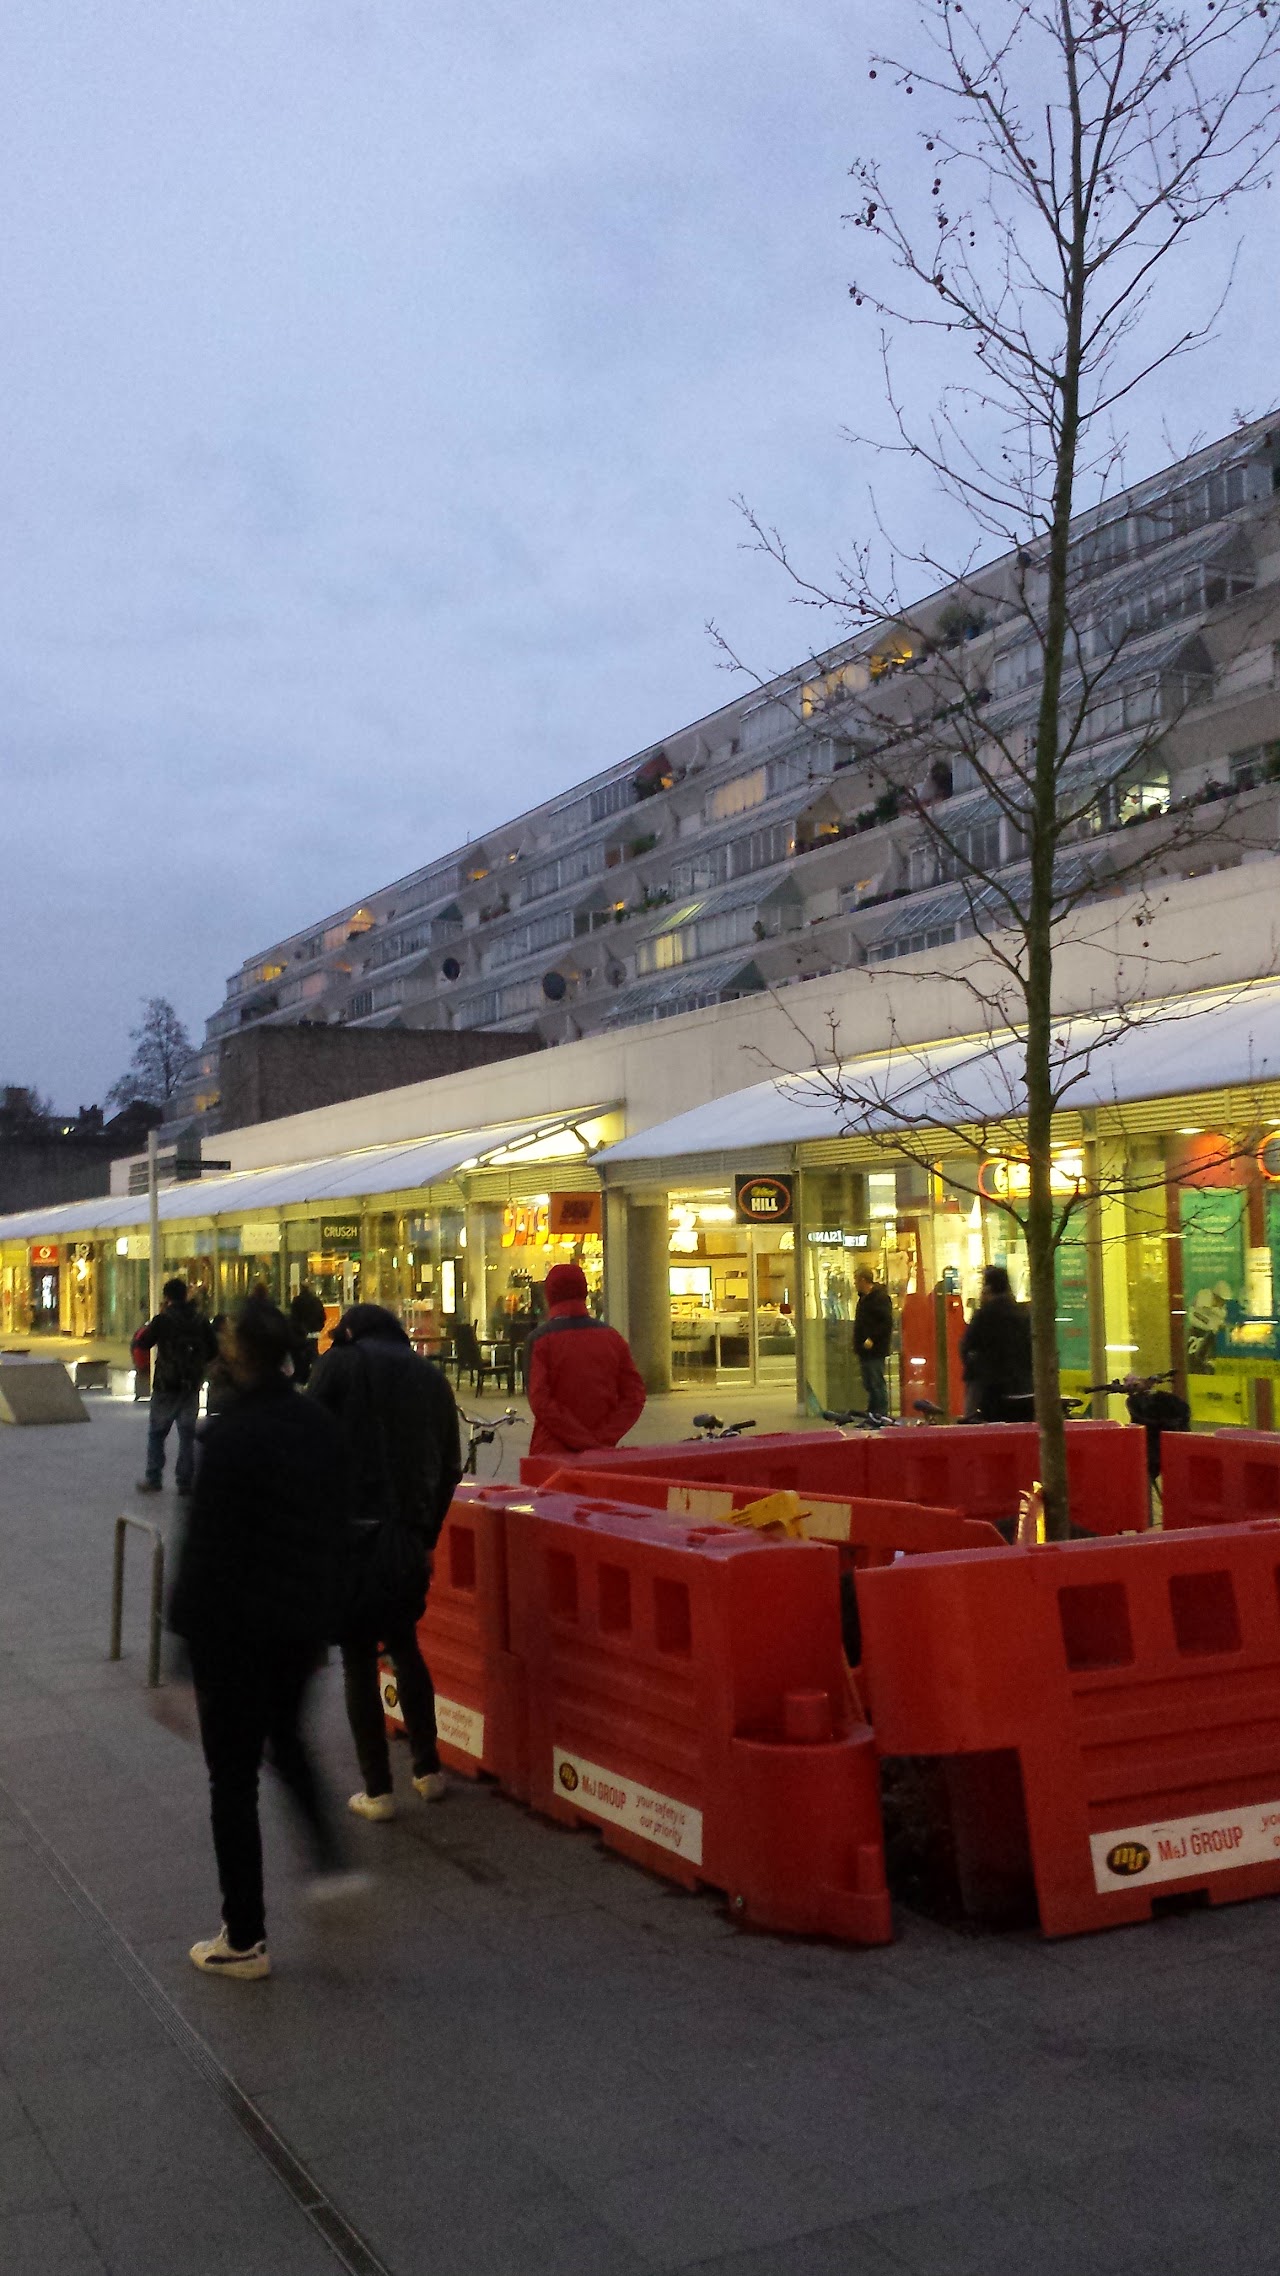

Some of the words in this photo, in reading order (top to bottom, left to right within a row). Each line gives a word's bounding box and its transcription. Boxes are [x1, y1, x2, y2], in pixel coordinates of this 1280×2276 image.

[751, 1197, 778, 1211] HILL
[598, 1781, 626, 1810] GROUP
[636, 1795, 655, 1808] your
[640, 1816, 653, 1828] our
[653, 1823, 683, 1847] priority
[1190, 1826, 1244, 1855] GROUP
